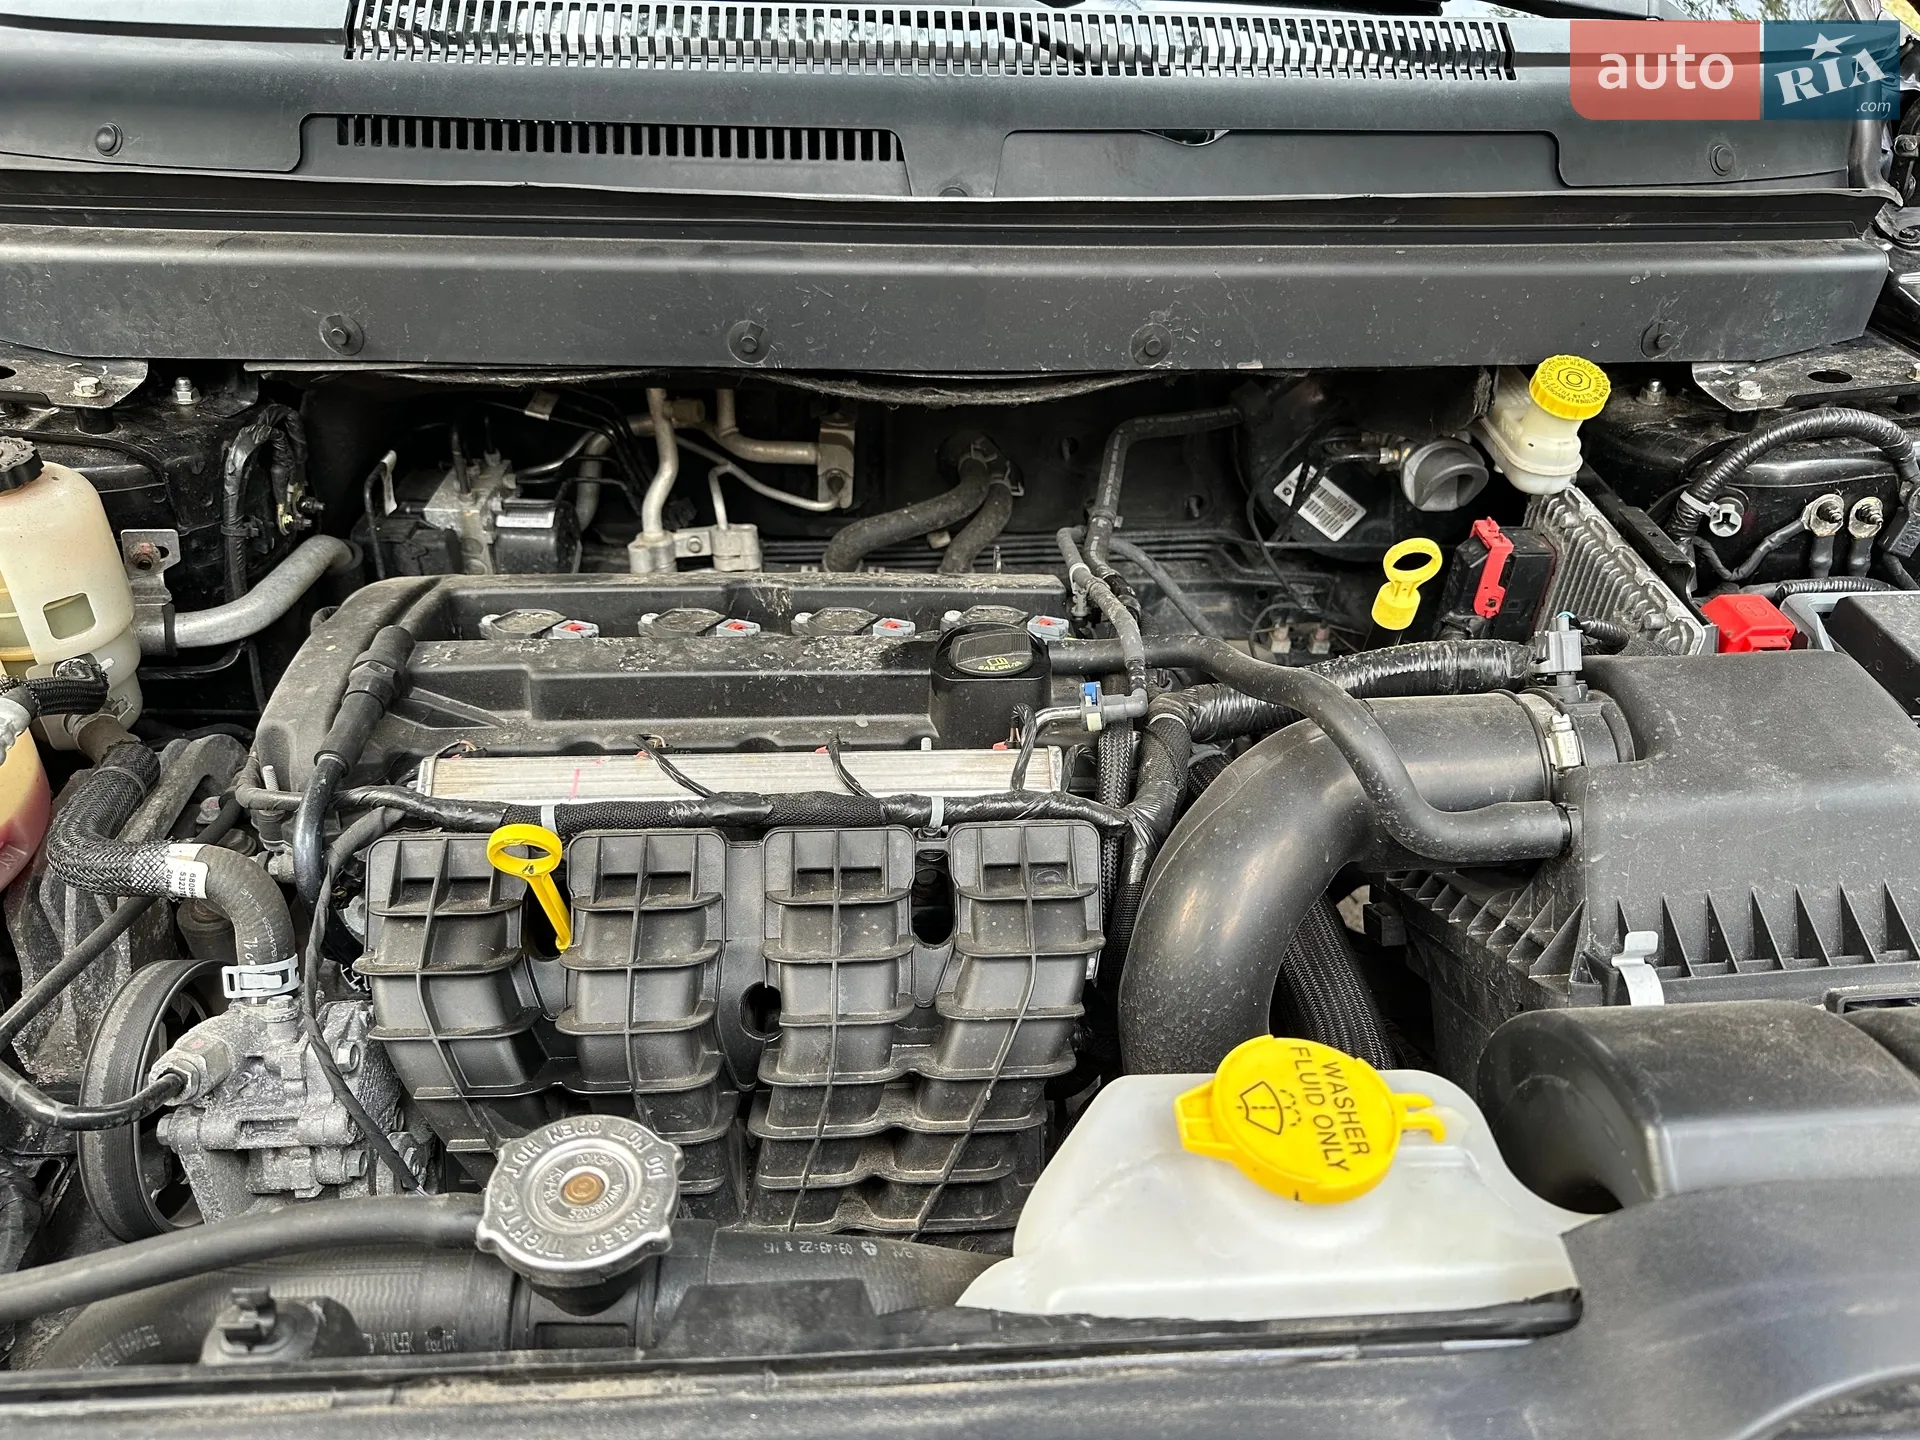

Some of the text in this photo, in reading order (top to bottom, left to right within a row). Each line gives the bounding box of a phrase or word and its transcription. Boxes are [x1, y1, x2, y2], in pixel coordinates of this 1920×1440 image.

[1289, 1046, 1350, 1172] FLUID ONLY
[1321, 1061, 1370, 1156] WASHER
[504, 1120, 666, 1180] DO NOT OPEN HOT
[498, 1209, 650, 1258] KEEP TIGHT
